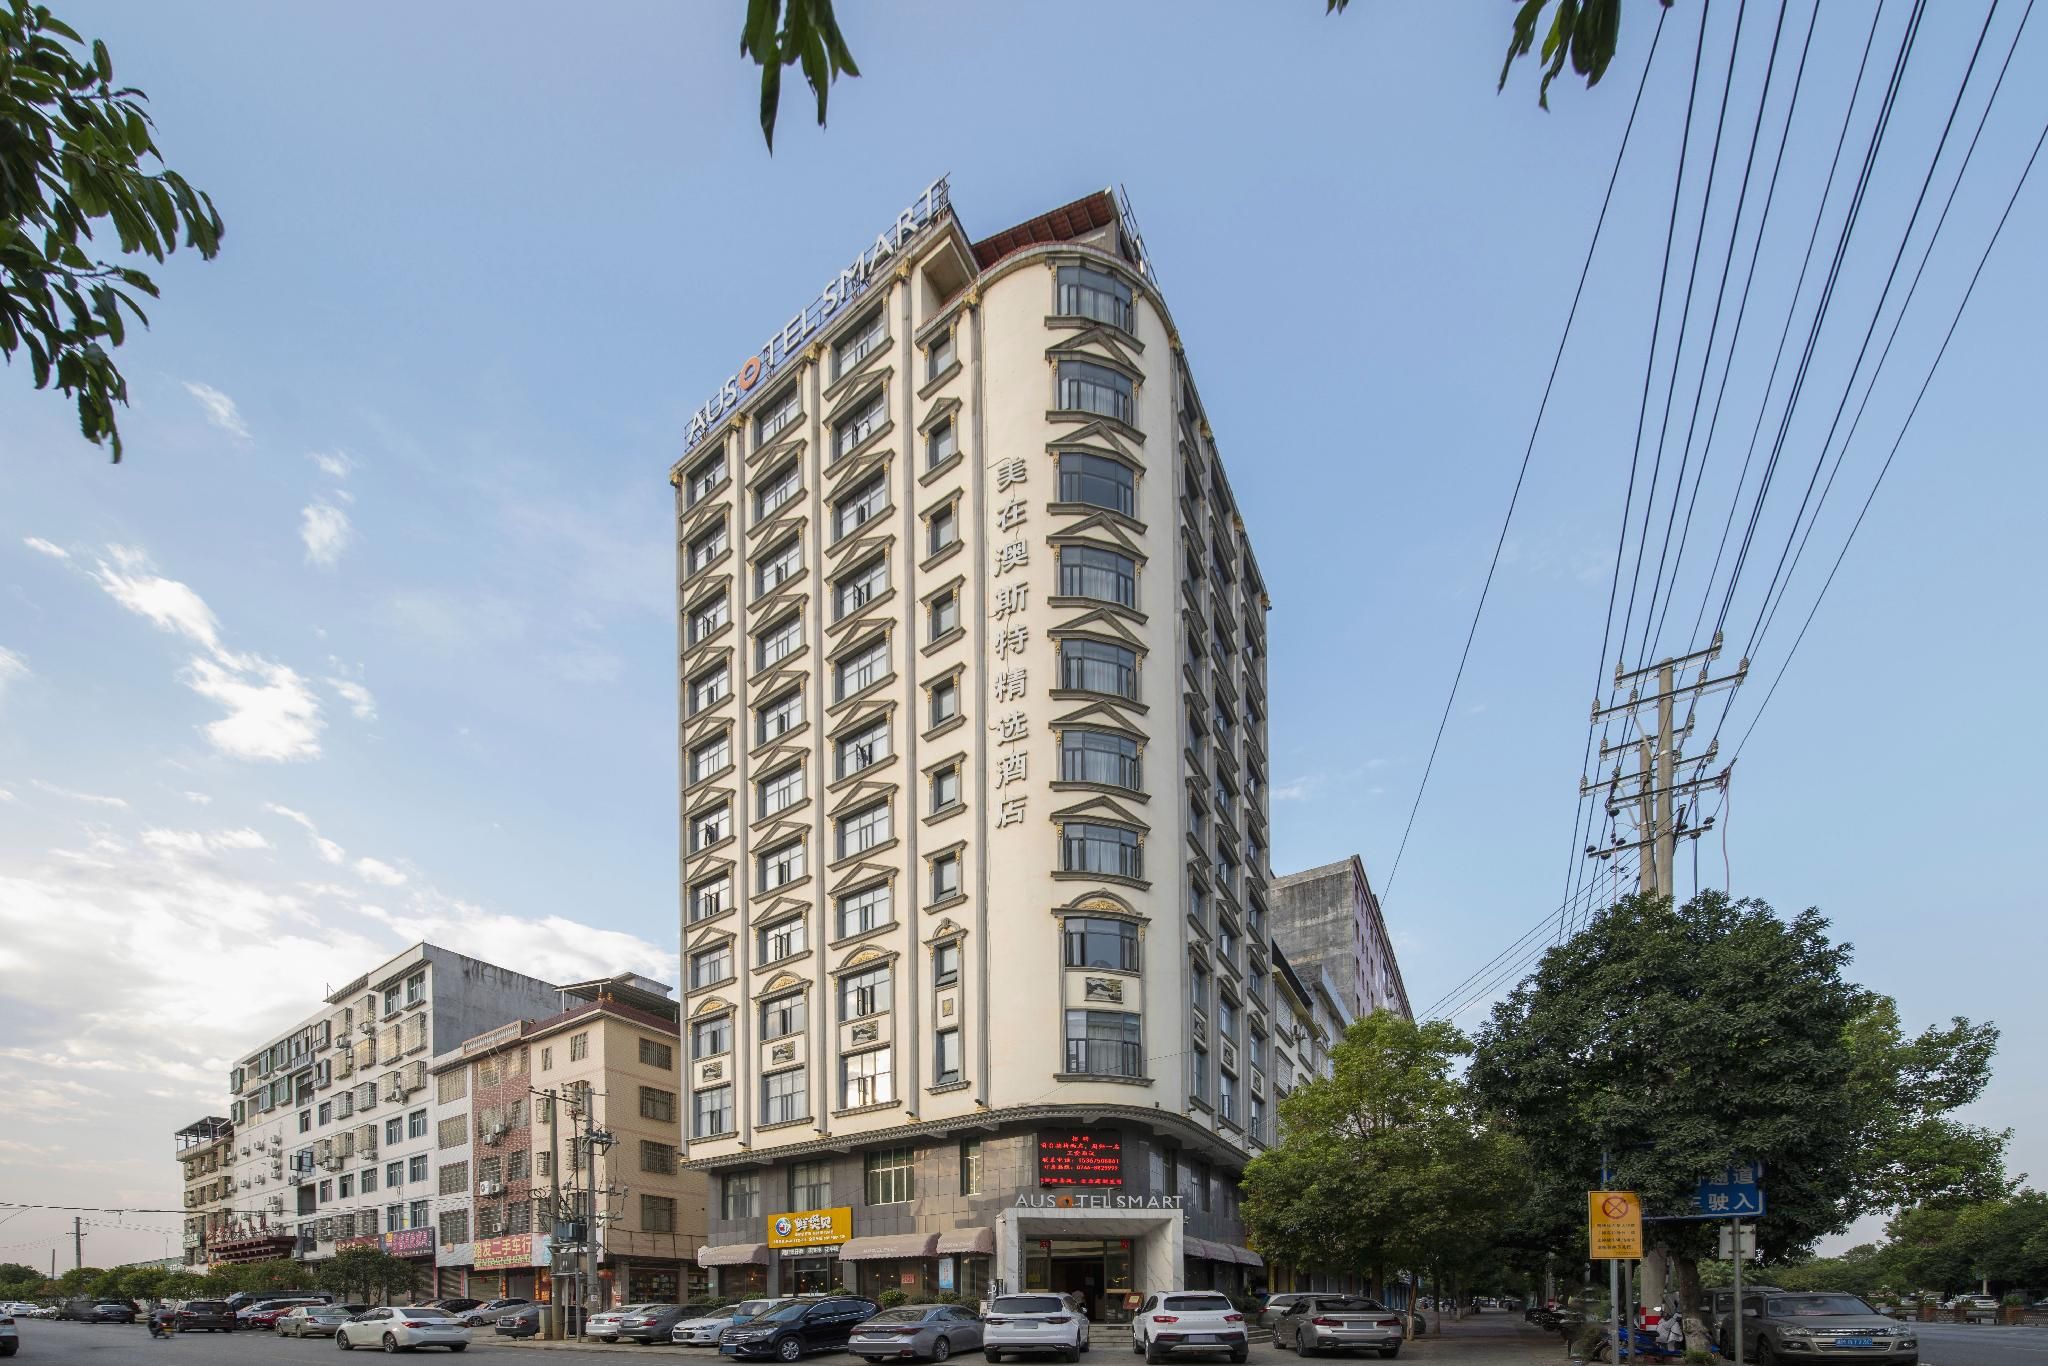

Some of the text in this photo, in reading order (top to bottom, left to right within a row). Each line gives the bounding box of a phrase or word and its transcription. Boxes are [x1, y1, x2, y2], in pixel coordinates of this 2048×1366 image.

[688, 176, 946, 445] AUSOTEL SMART
[994, 457, 1028, 828] 美在澳斯特精选酒店
[1015, 1194, 1184, 1208] AUSOTEL SMART
